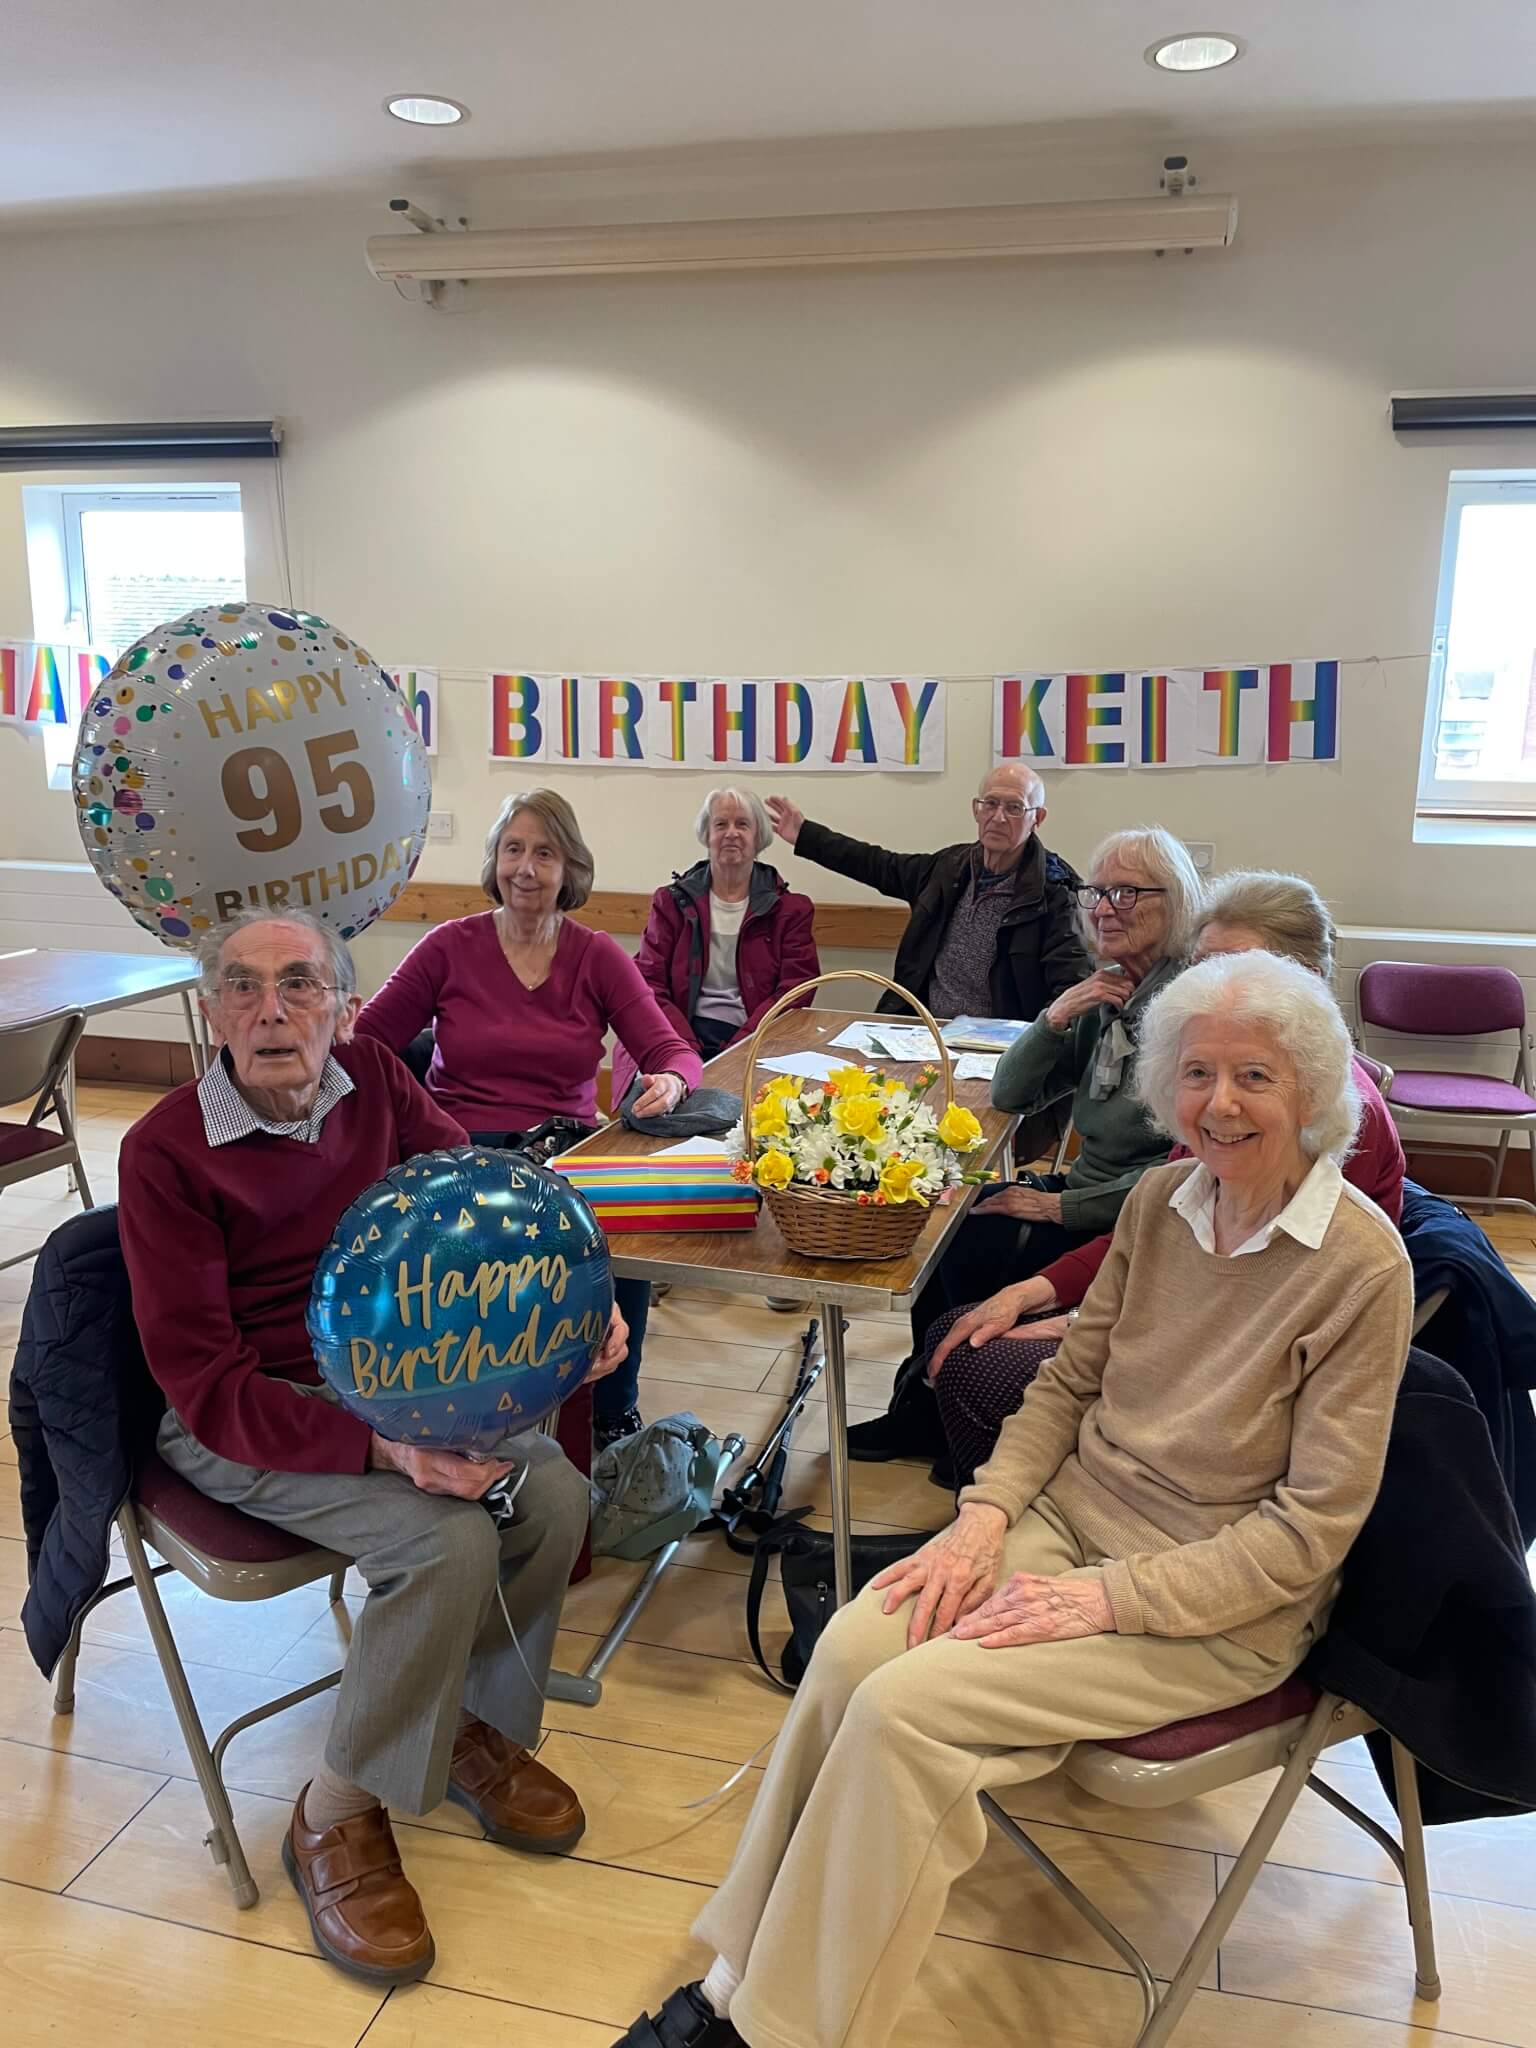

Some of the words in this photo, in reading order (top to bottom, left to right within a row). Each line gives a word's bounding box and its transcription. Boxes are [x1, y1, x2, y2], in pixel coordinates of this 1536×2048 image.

[199, 668, 347, 739] HAPPY
[492, 675, 939, 766] BIRTHDAY
[1002, 660, 1338, 764] KEITH
[221, 729, 375, 853] 95
[394, 1253, 571, 1327] Happy
[350, 1303, 603, 1399] Birthday
